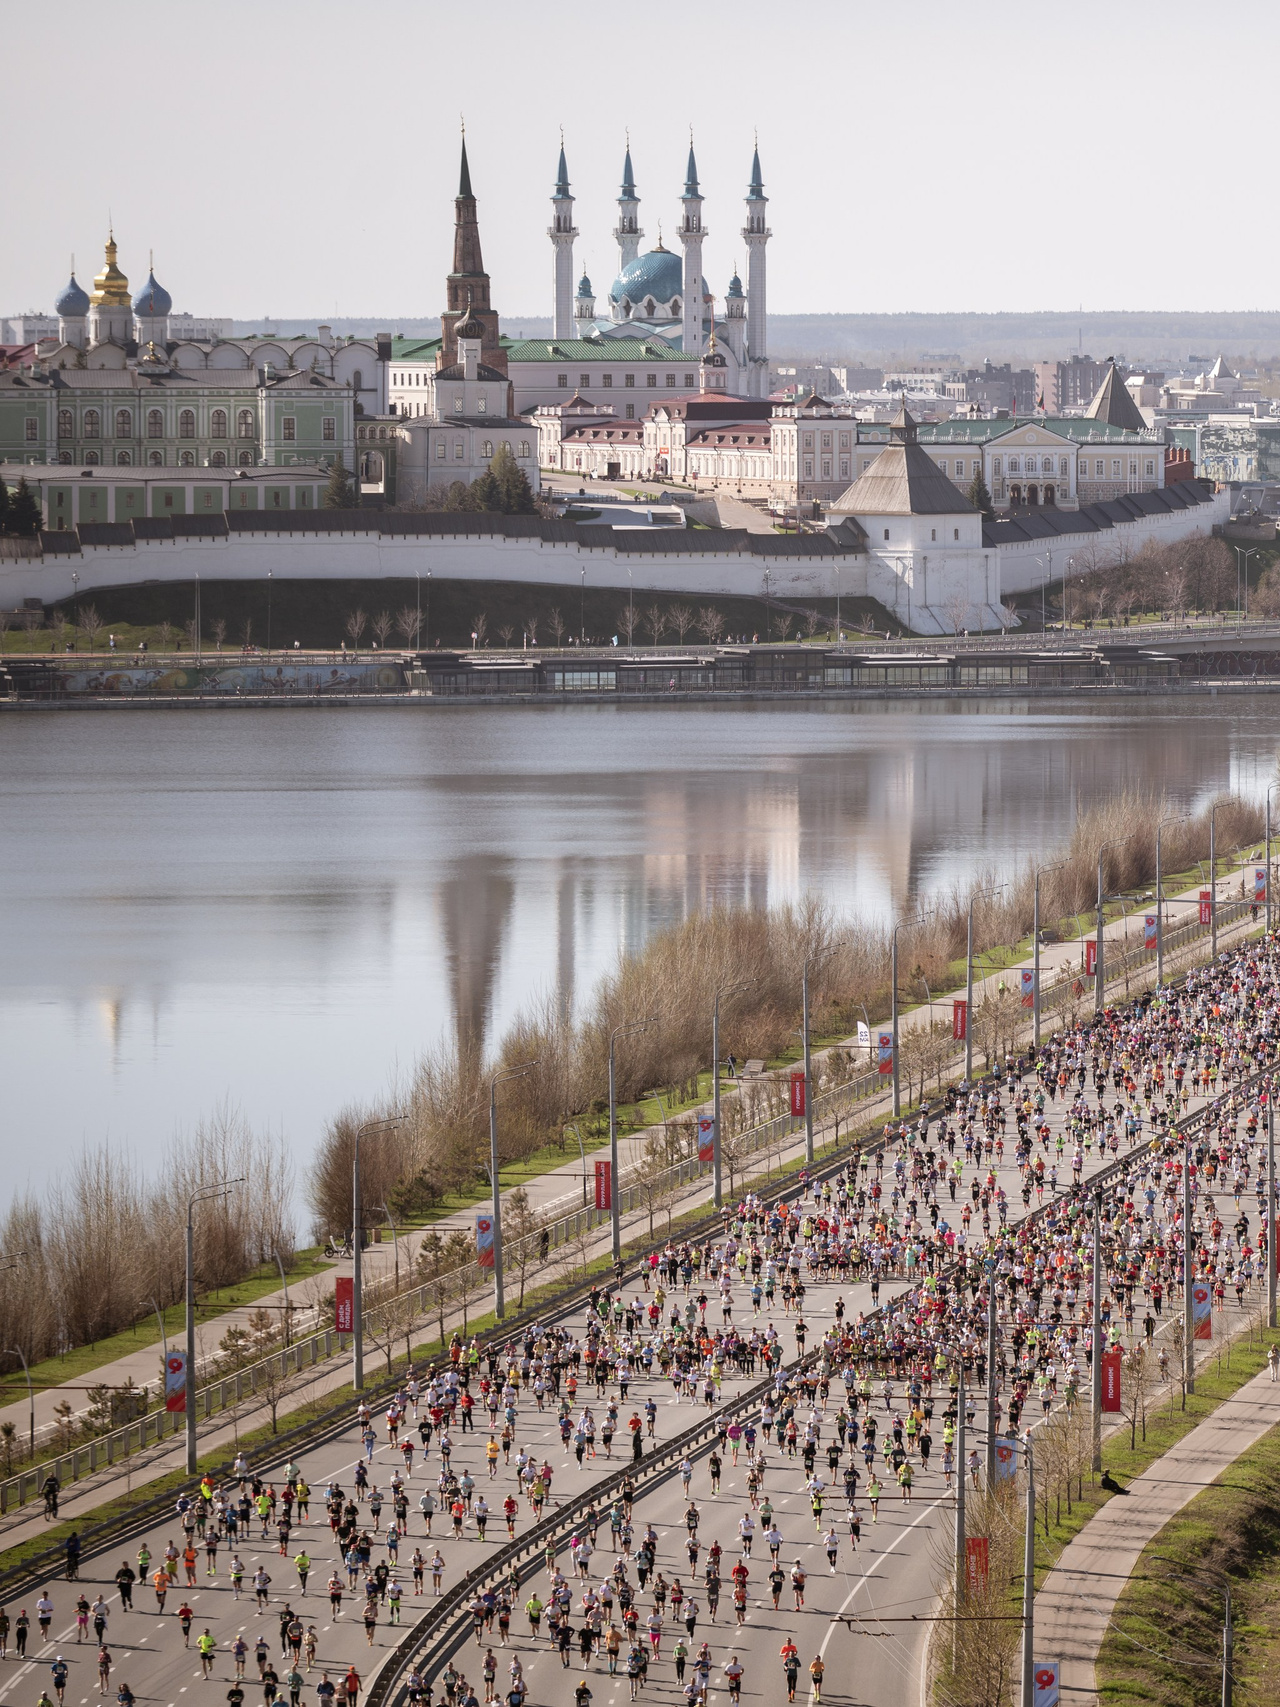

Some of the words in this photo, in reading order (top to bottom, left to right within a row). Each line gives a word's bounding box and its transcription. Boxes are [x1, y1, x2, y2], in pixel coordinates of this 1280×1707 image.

[478, 1219, 491, 1234] 9
[1194, 1288, 1208, 1304] 9
[168, 1357, 183, 1374] 9
[1035, 1669, 1055, 1690] 9
